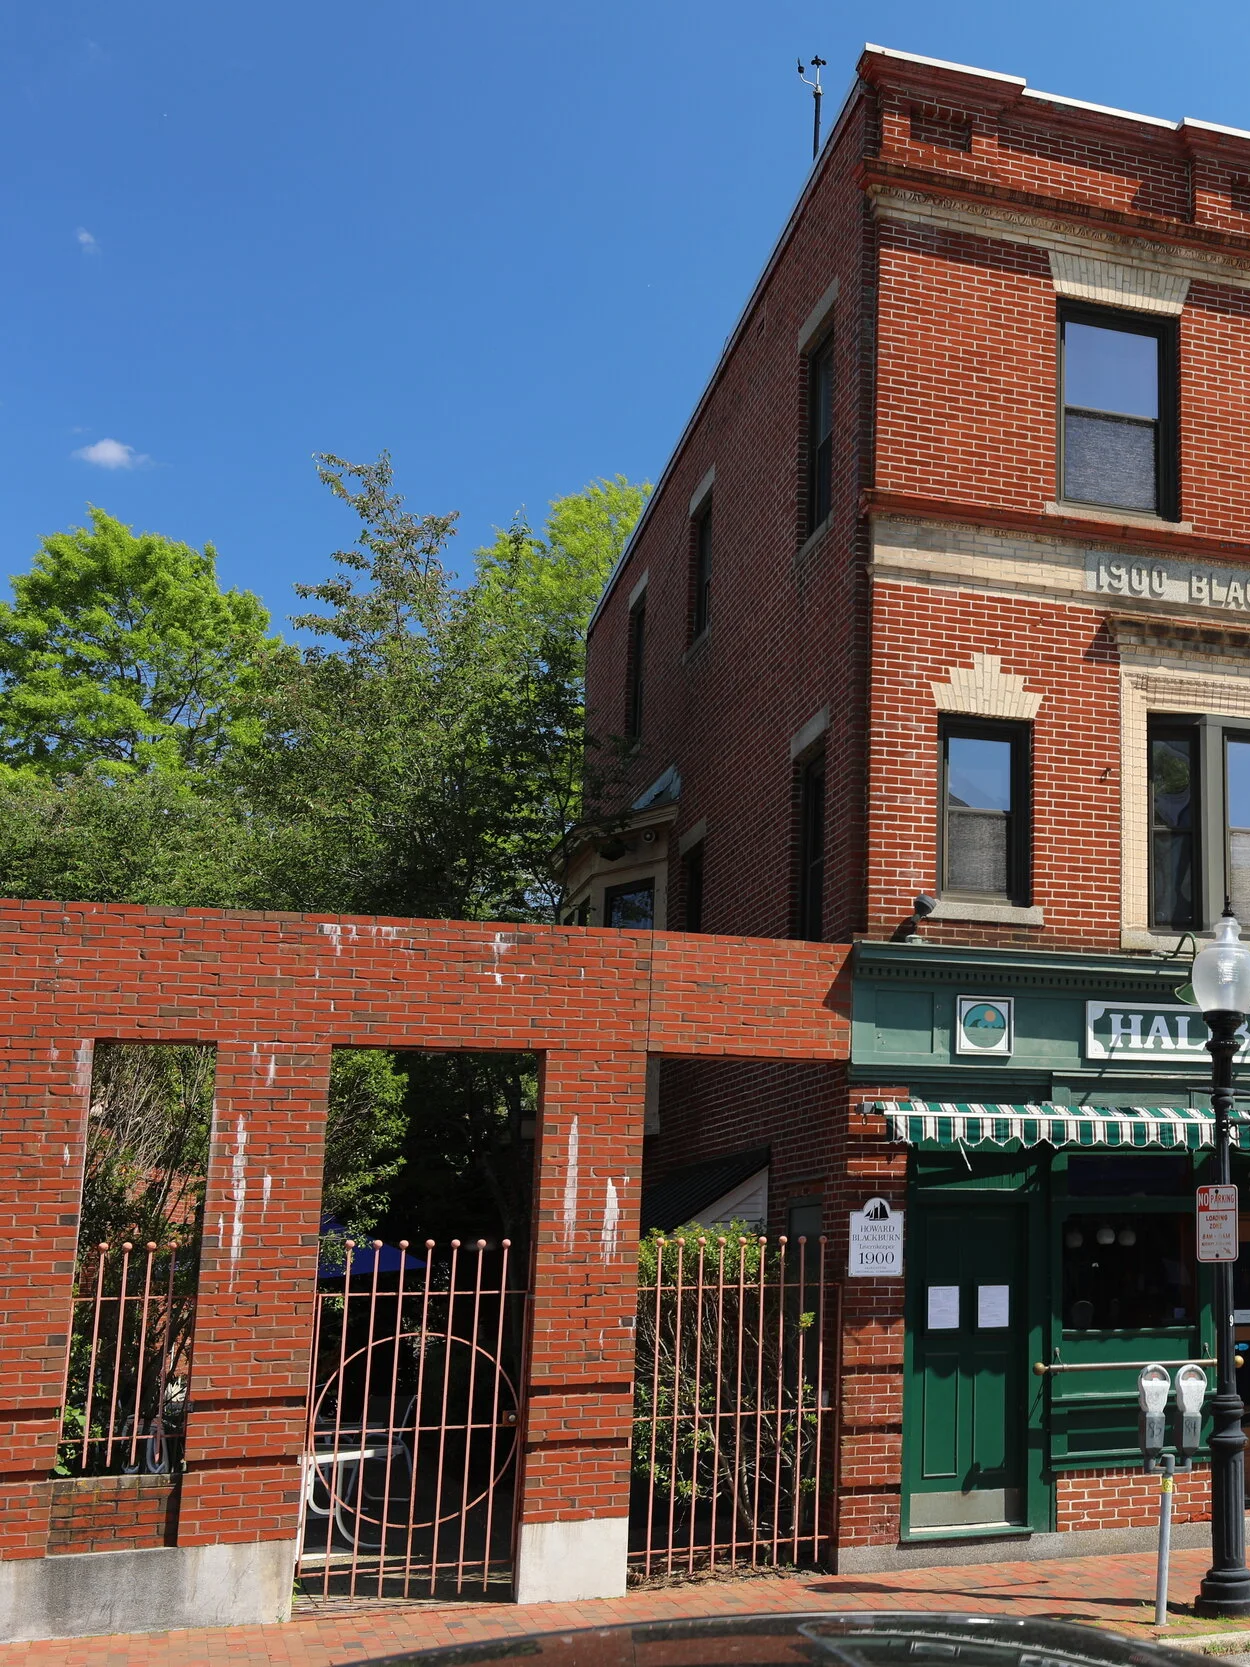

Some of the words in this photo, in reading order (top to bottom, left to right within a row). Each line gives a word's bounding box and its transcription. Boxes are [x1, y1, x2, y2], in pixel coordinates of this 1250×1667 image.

[1098, 561, 1168, 598] 1900
[1198, 1193, 1208, 1206] NO
[1210, 1194, 1234, 1204] PARKING
[859, 1251, 894, 1264] 1900
[1229, 1314, 1234, 1327] 9
